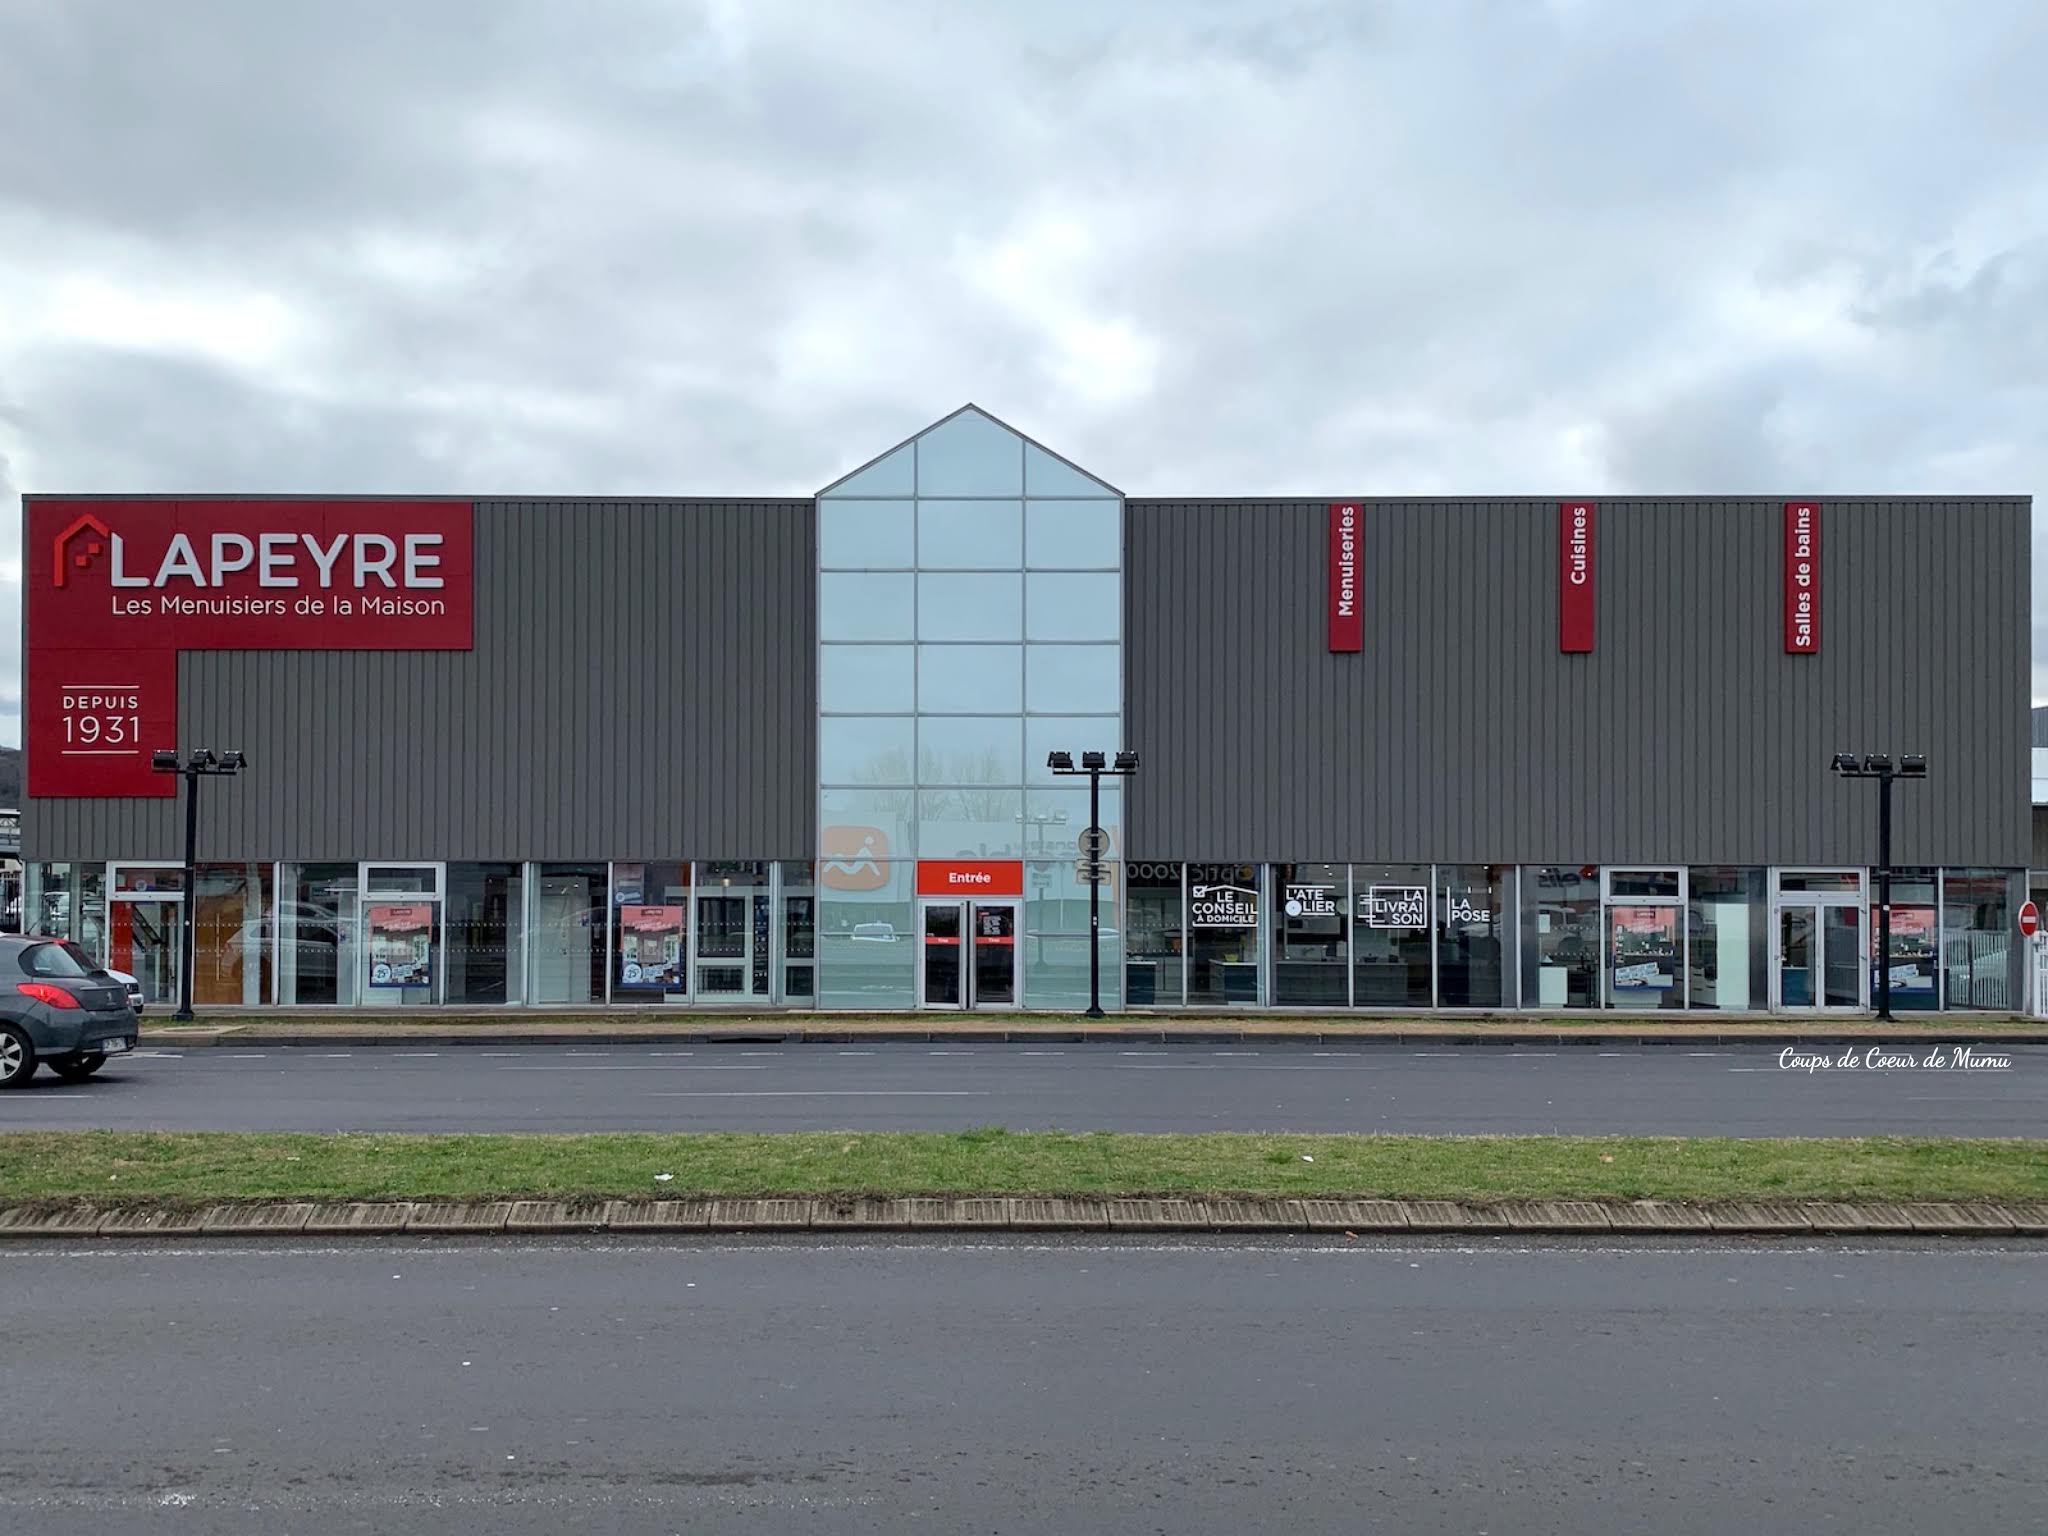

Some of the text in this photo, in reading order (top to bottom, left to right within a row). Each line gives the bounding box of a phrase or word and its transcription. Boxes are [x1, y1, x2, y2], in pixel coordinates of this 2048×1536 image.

[1570, 507, 1586, 585] Cuisines
[111, 532, 445, 588] LAPEYRE
[1338, 506, 1354, 616] Menuiseries
[1795, 507, 1811, 646] Salles de bains
[112, 595, 445, 615] Les Menuisiers de la Maison
[63, 696, 138, 709] DEPUIS
[62, 715, 138, 743] 1931
[949, 872, 991, 883] Entrée
[1216, 891, 1234, 903] LE
[1286, 889, 1324, 900] L'ATE
[1404, 890, 1423, 901] LA
[1192, 902, 1259, 914] CONSEIL
[1303, 901, 1335, 912] LIER
[1375, 902, 1423, 913] LIVRAI
[1451, 898, 1470, 909] LA
[1206, 914, 1255, 923] DOMICILE
[1392, 914, 1423, 925] SON
[1451, 910, 1490, 922] POSE
